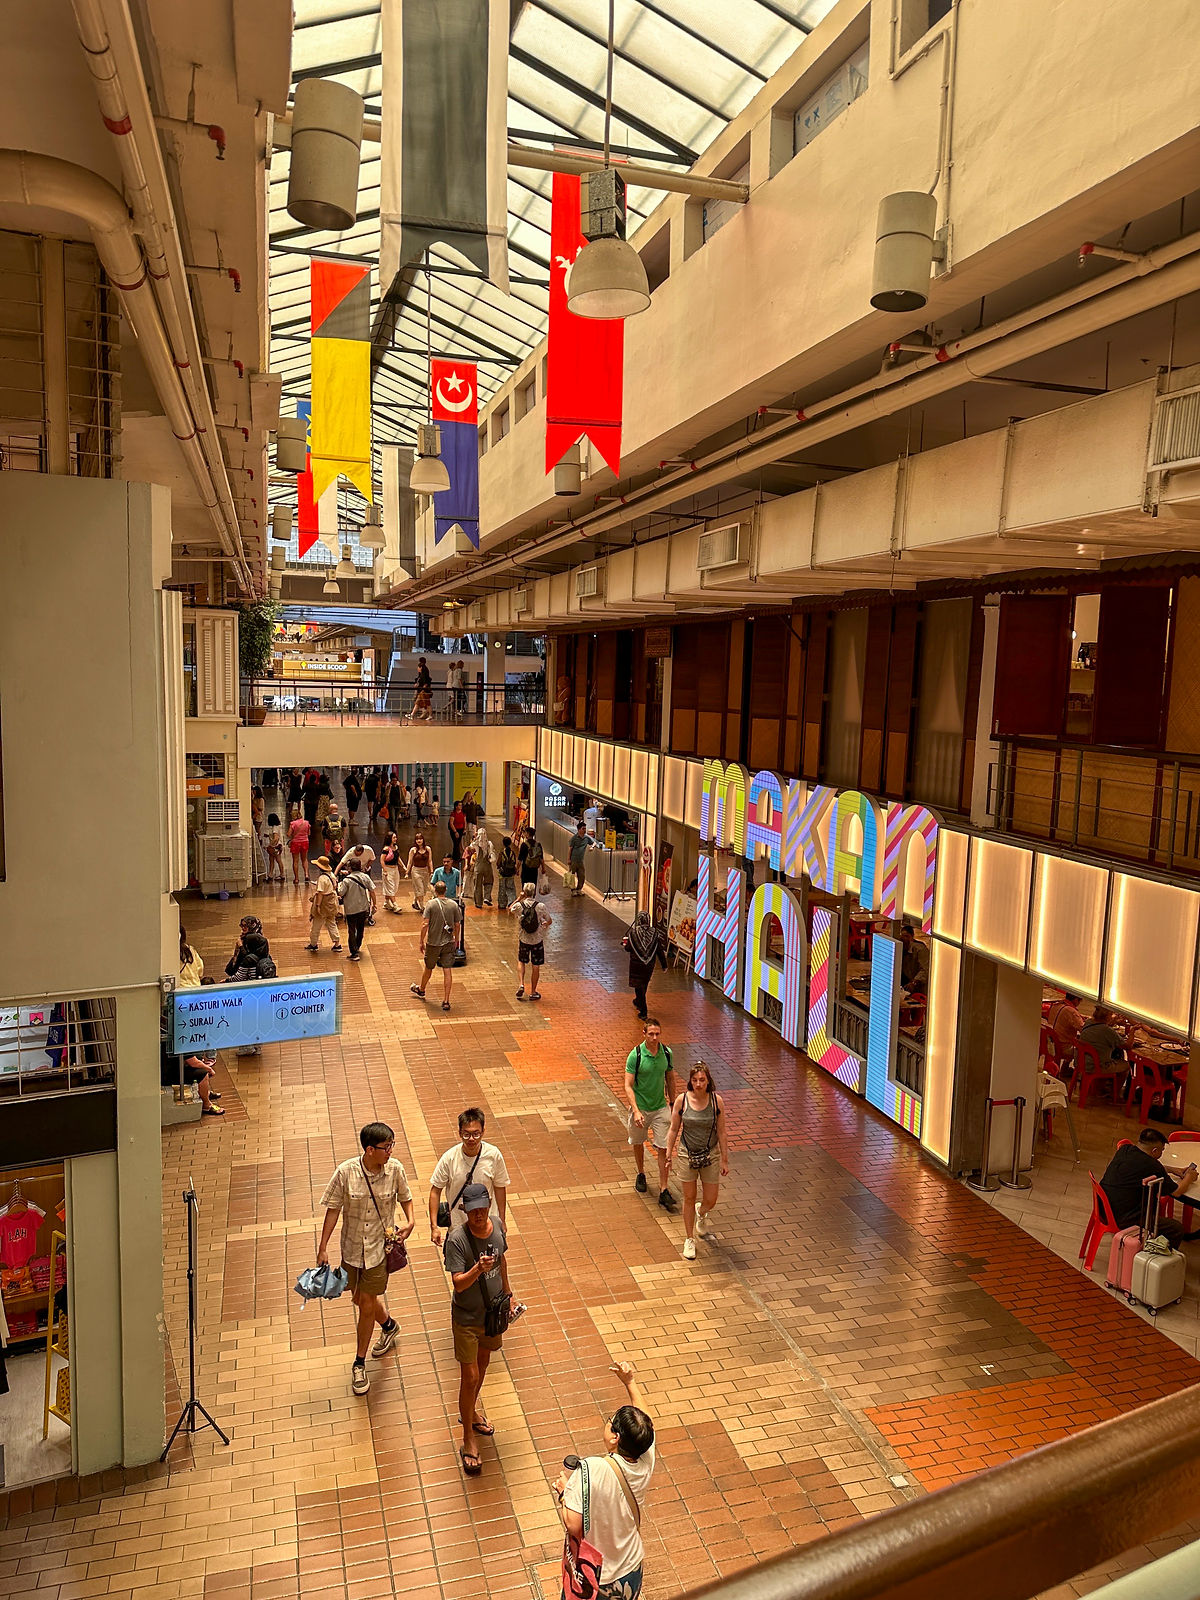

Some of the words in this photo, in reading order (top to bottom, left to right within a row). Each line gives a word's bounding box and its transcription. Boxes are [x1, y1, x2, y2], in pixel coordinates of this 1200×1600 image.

[270, 989, 326, 1003] INFORMATION
[694, 854, 922, 1139] HALL
[188, 1000, 220, 1012] KASTURI
[221, 997, 243, 1008] WALK
[290, 1003, 325, 1016] COUNTER
[189, 1016, 214, 1028] SURAU
[189, 1033, 206, 1044] ATM
[8, 1228, 27, 1242] LAH
